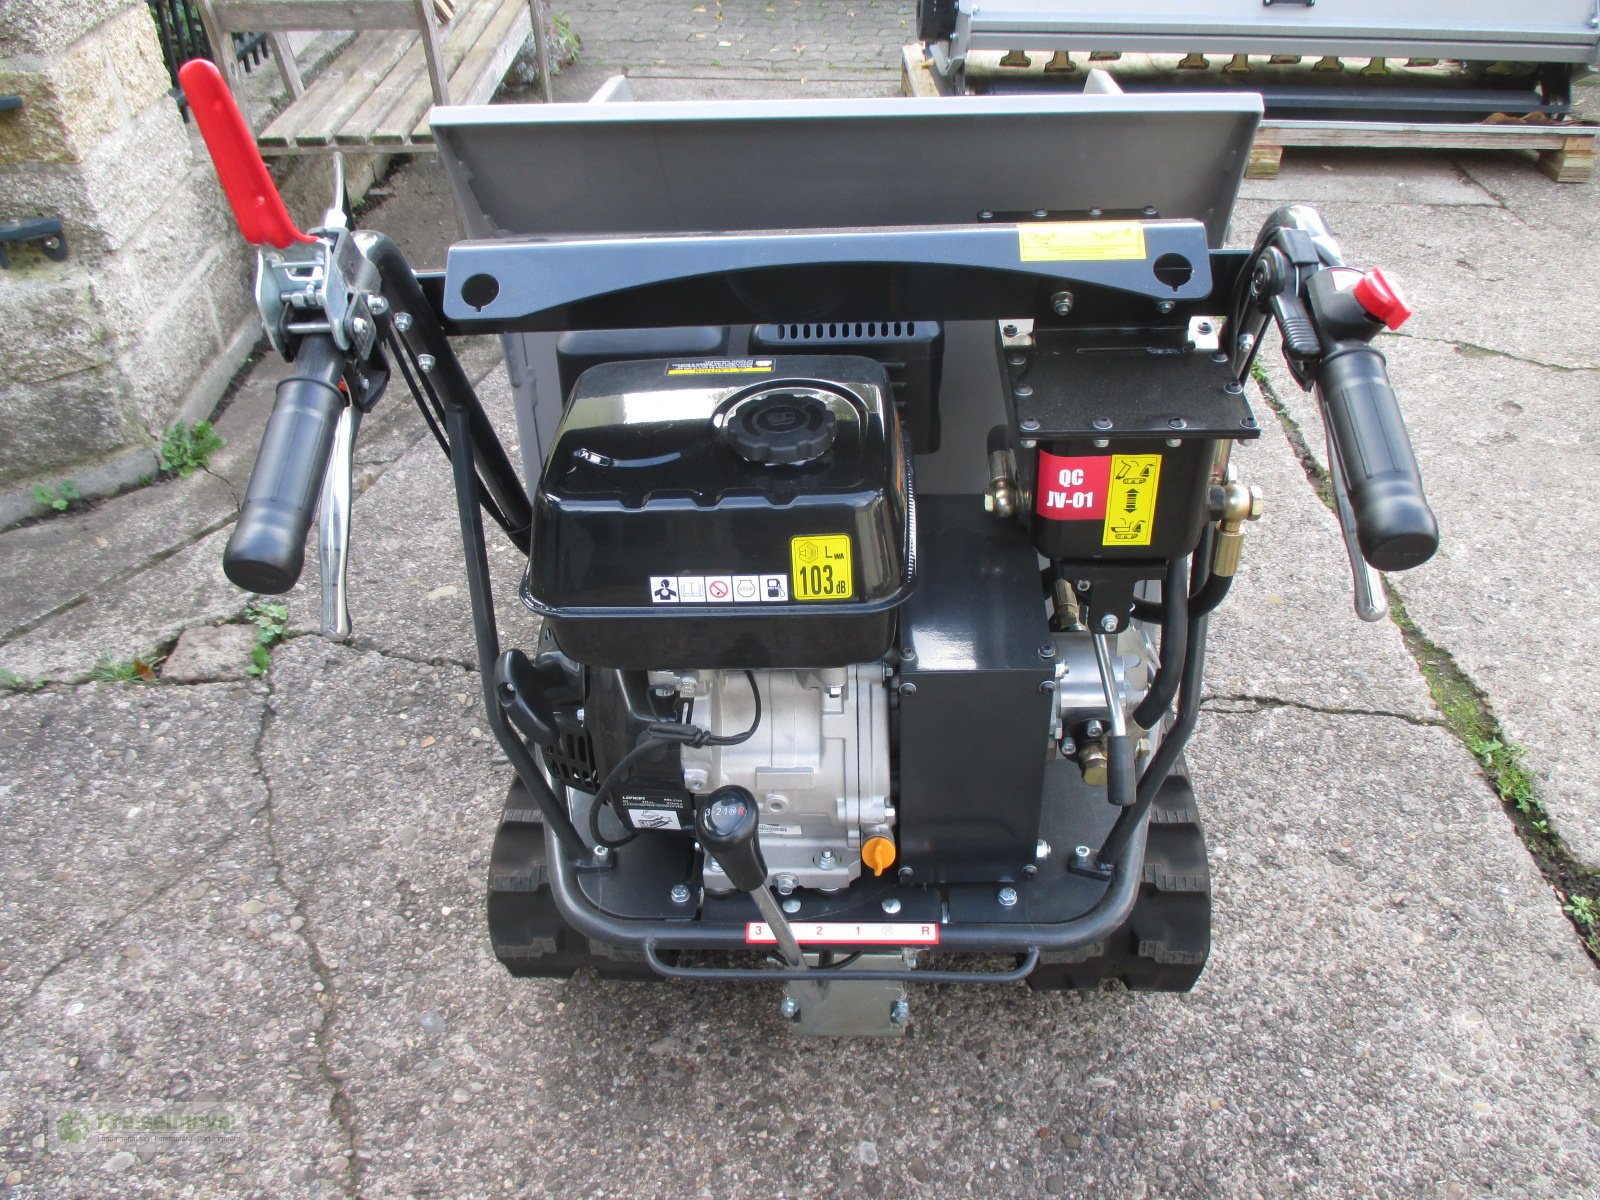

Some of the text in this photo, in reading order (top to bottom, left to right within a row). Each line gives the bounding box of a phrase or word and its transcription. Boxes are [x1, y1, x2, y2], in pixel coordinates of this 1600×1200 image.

[1058, 469, 1084, 488] QC
[1046, 490, 1094, 508] JV-01
[799, 565, 846, 595] 103 dB
[754, 926, 762, 936] 3
[816, 926, 823, 935] 2
[855, 926, 861, 935] 1
[921, 926, 930, 935] R
